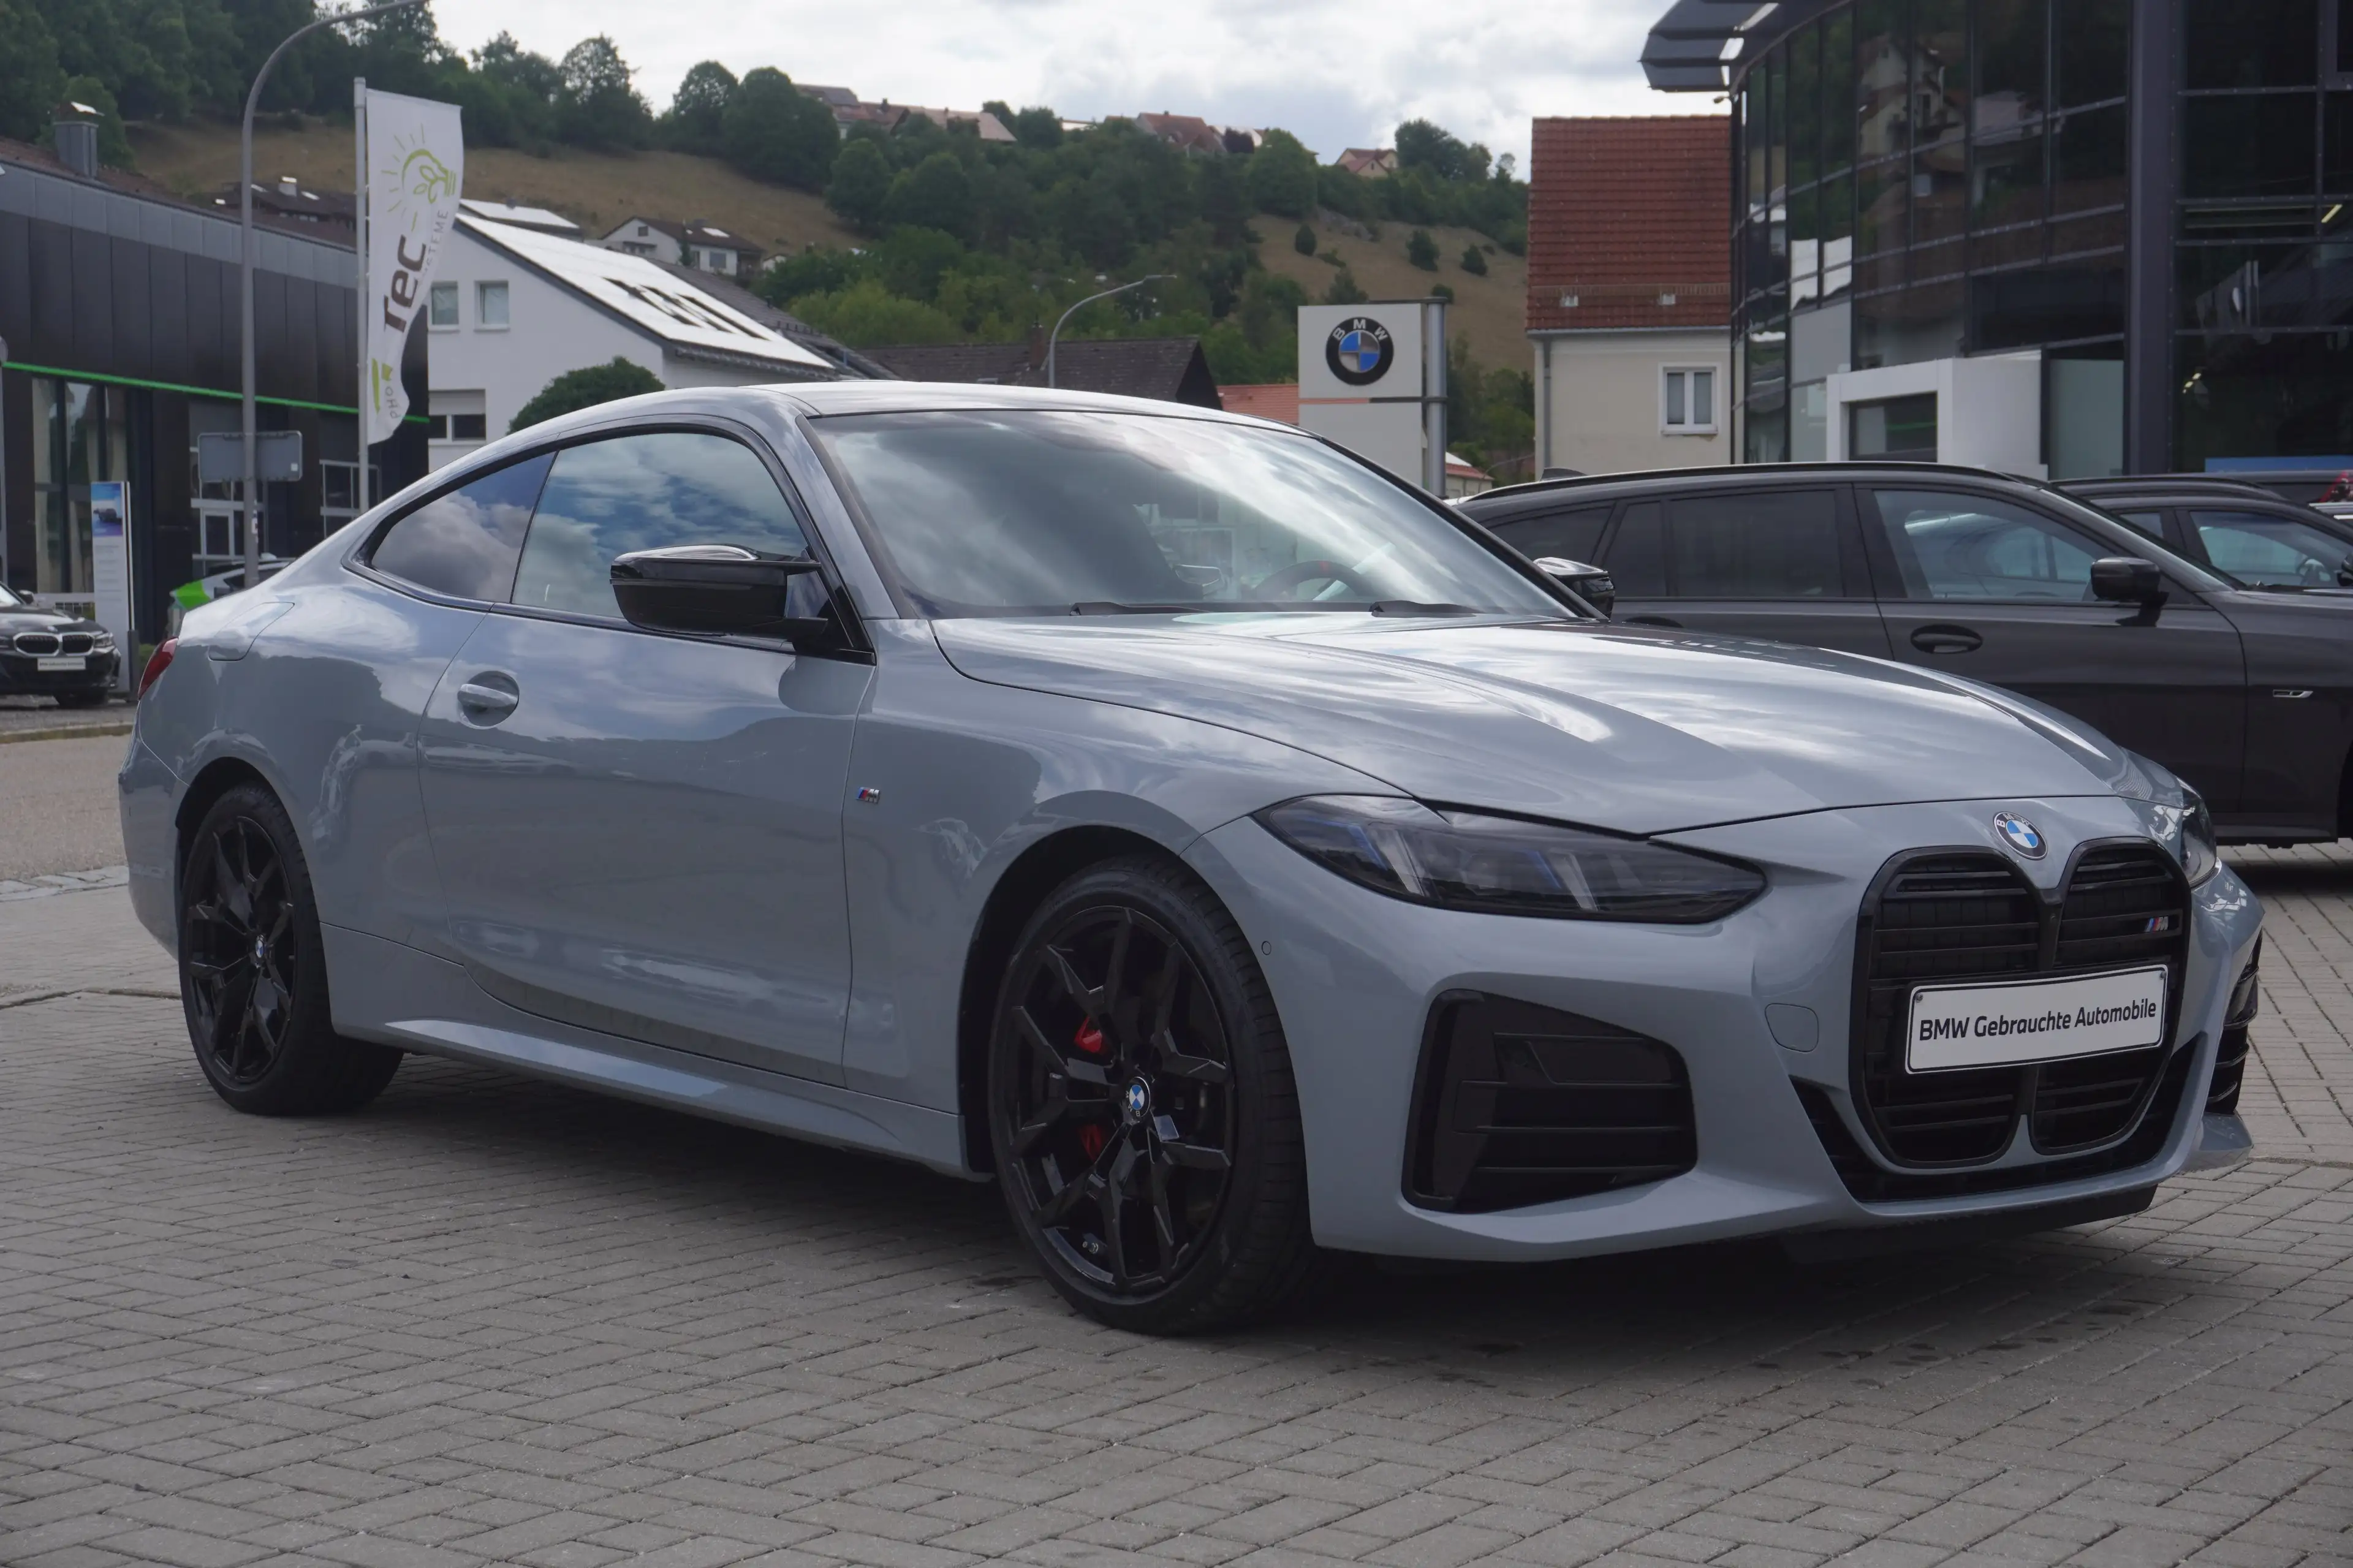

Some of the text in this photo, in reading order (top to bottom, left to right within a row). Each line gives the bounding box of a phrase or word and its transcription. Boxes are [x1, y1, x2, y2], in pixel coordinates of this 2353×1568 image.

[1333, 319, 1388, 341] BMW
[384, 386, 401, 419] PHO
[1996, 814, 2029, 828] BMW
[1919, 998, 2156, 1041] BMW Gebrauchte Automobile
